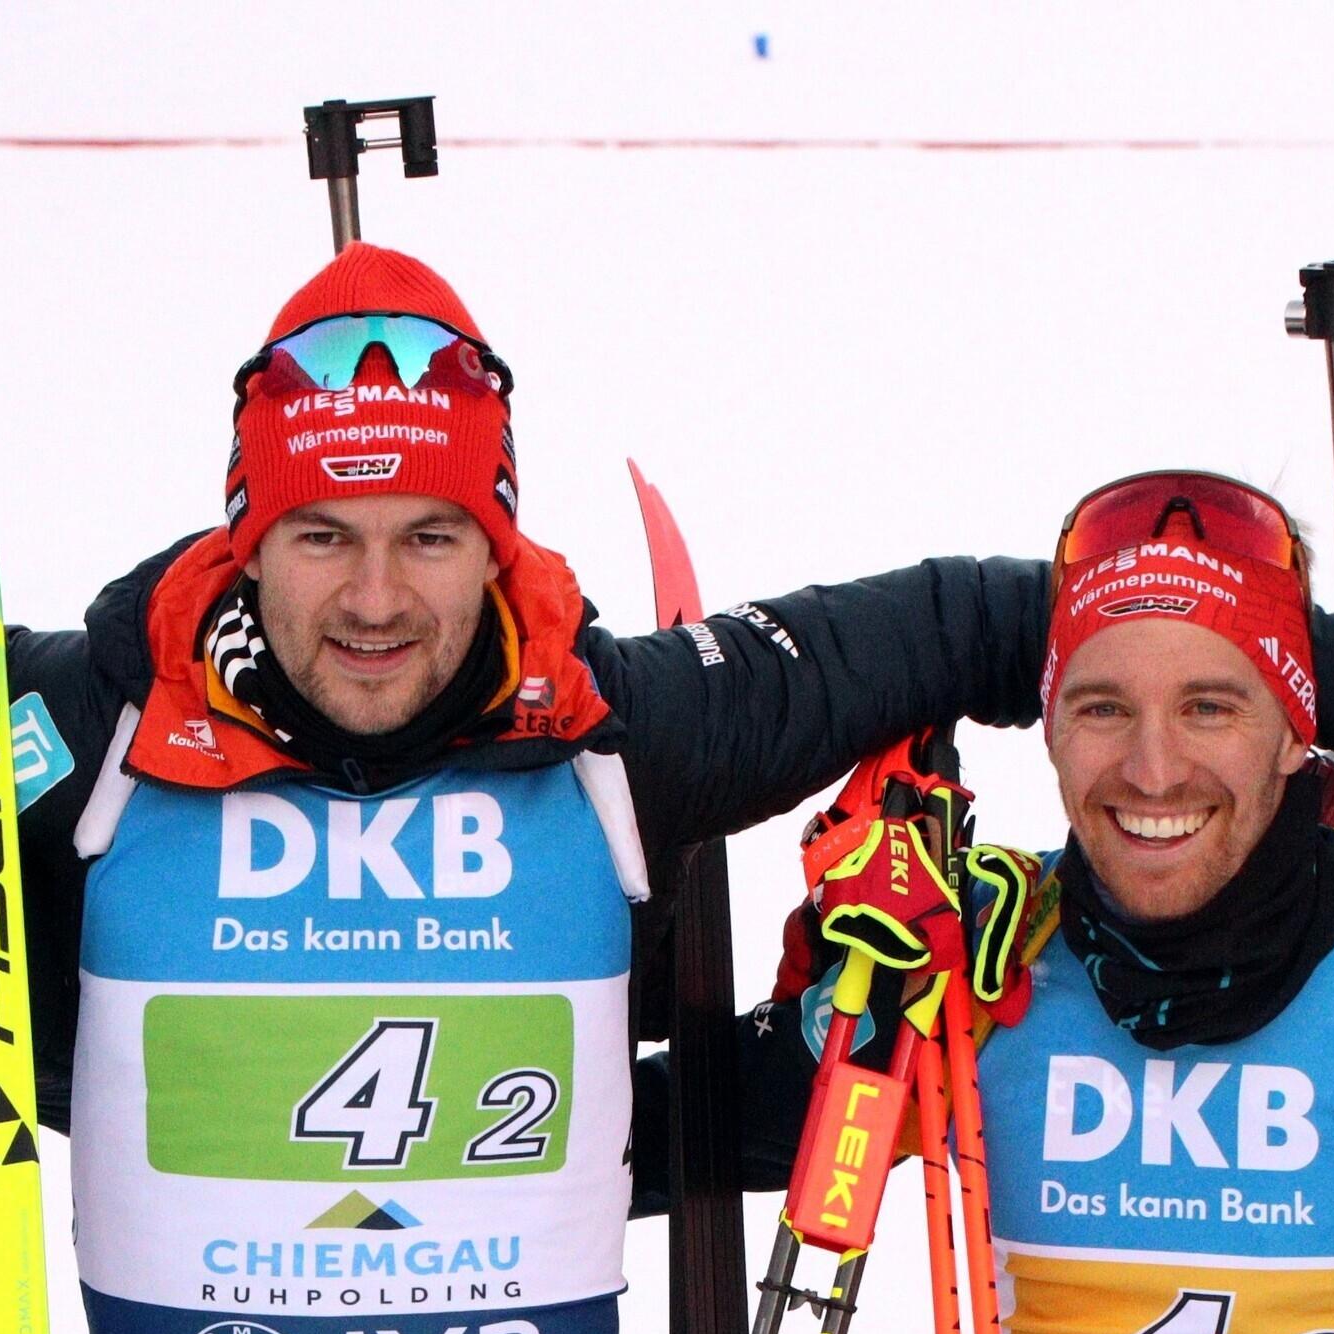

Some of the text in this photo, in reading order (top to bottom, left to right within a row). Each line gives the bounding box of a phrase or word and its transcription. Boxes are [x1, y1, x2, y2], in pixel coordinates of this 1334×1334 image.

[287, 424, 448, 455] Wärmepumpen
[1072, 543, 1244, 592] VIESSMANN
[1070, 572, 1237, 616] Wärmepumpen
[218, 792, 512, 900] DKB
[888, 824, 909, 896] LEKI
[212, 917, 512, 951] Das kann Bank
[290, 1017, 560, 1170] 4 2
[1043, 1055, 1319, 1172] DKB
[821, 1082, 880, 1228] LEKI
[1041, 1180, 1315, 1226] Das kann Bank
[202, 1236, 522, 1278] CHIEMGAU
[202, 1281, 523, 1306] RUHPOLDING
